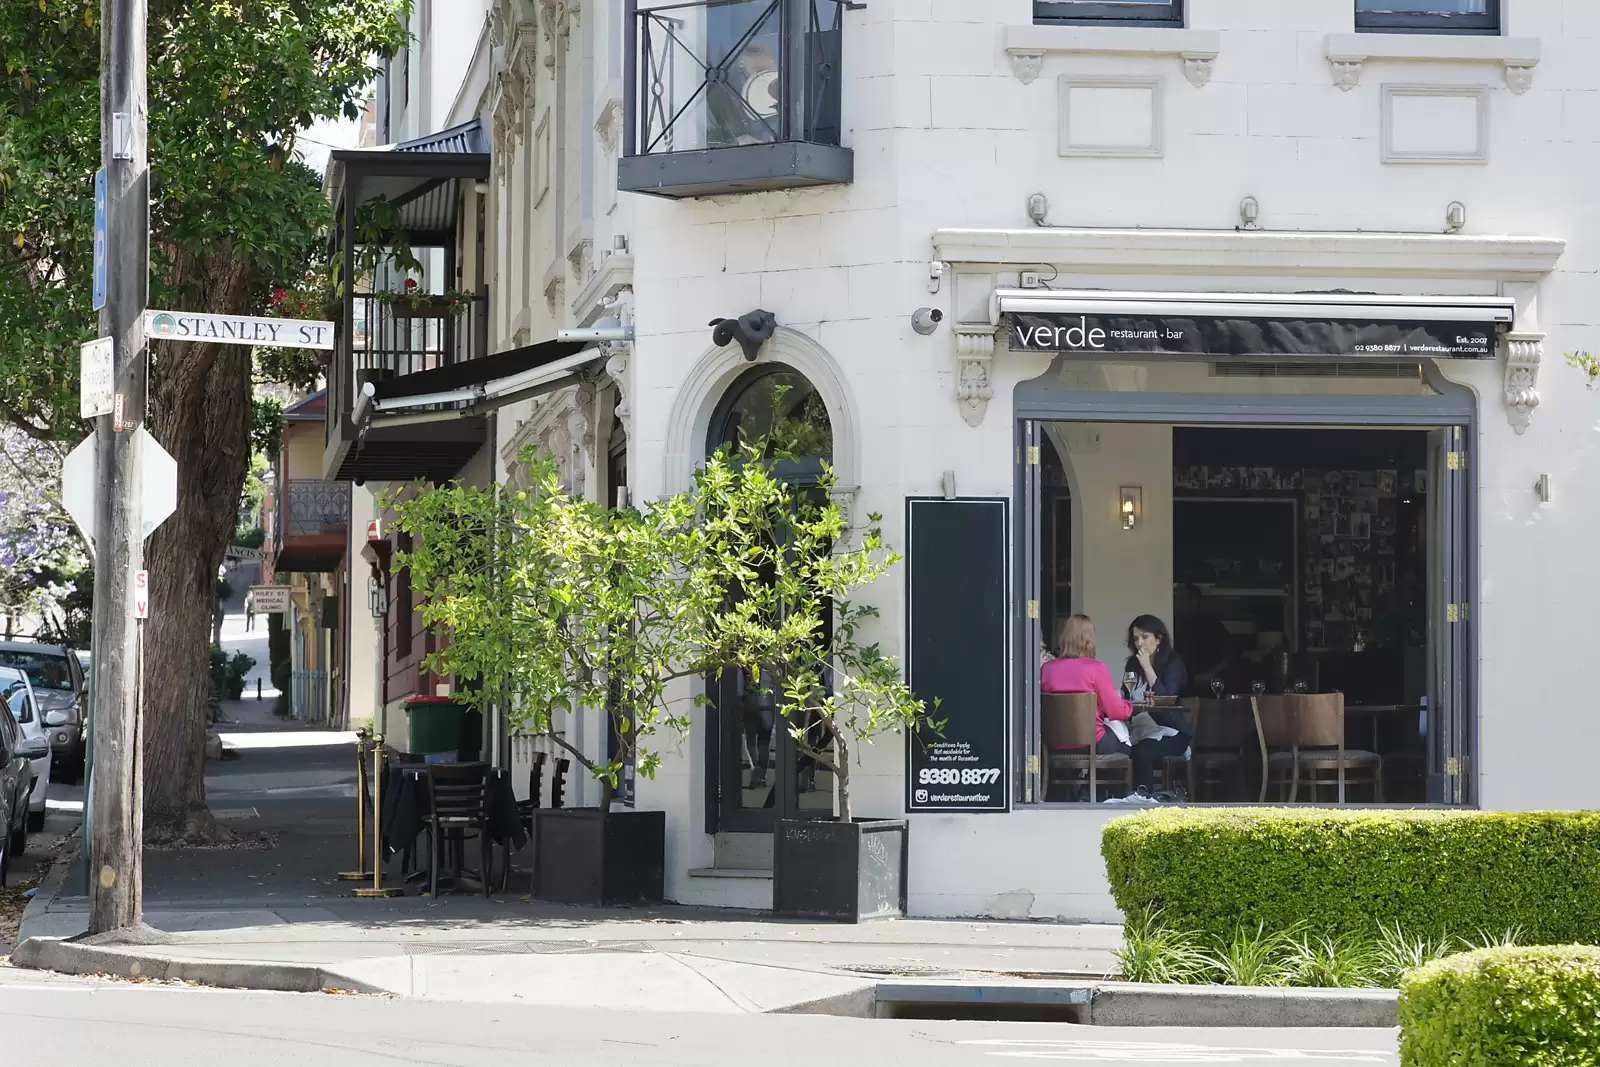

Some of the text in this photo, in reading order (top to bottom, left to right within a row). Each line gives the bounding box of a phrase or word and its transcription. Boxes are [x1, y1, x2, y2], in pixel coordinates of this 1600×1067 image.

[177, 317, 327, 344] STANLEY ST
[1016, 316, 1106, 347] verde
[1110, 329, 1158, 339] restaurant
[1166, 328, 1184, 339] bar
[1409, 344, 1488, 353] verderestaurant.com.au
[919, 768, 1000, 784] 9380 8877
